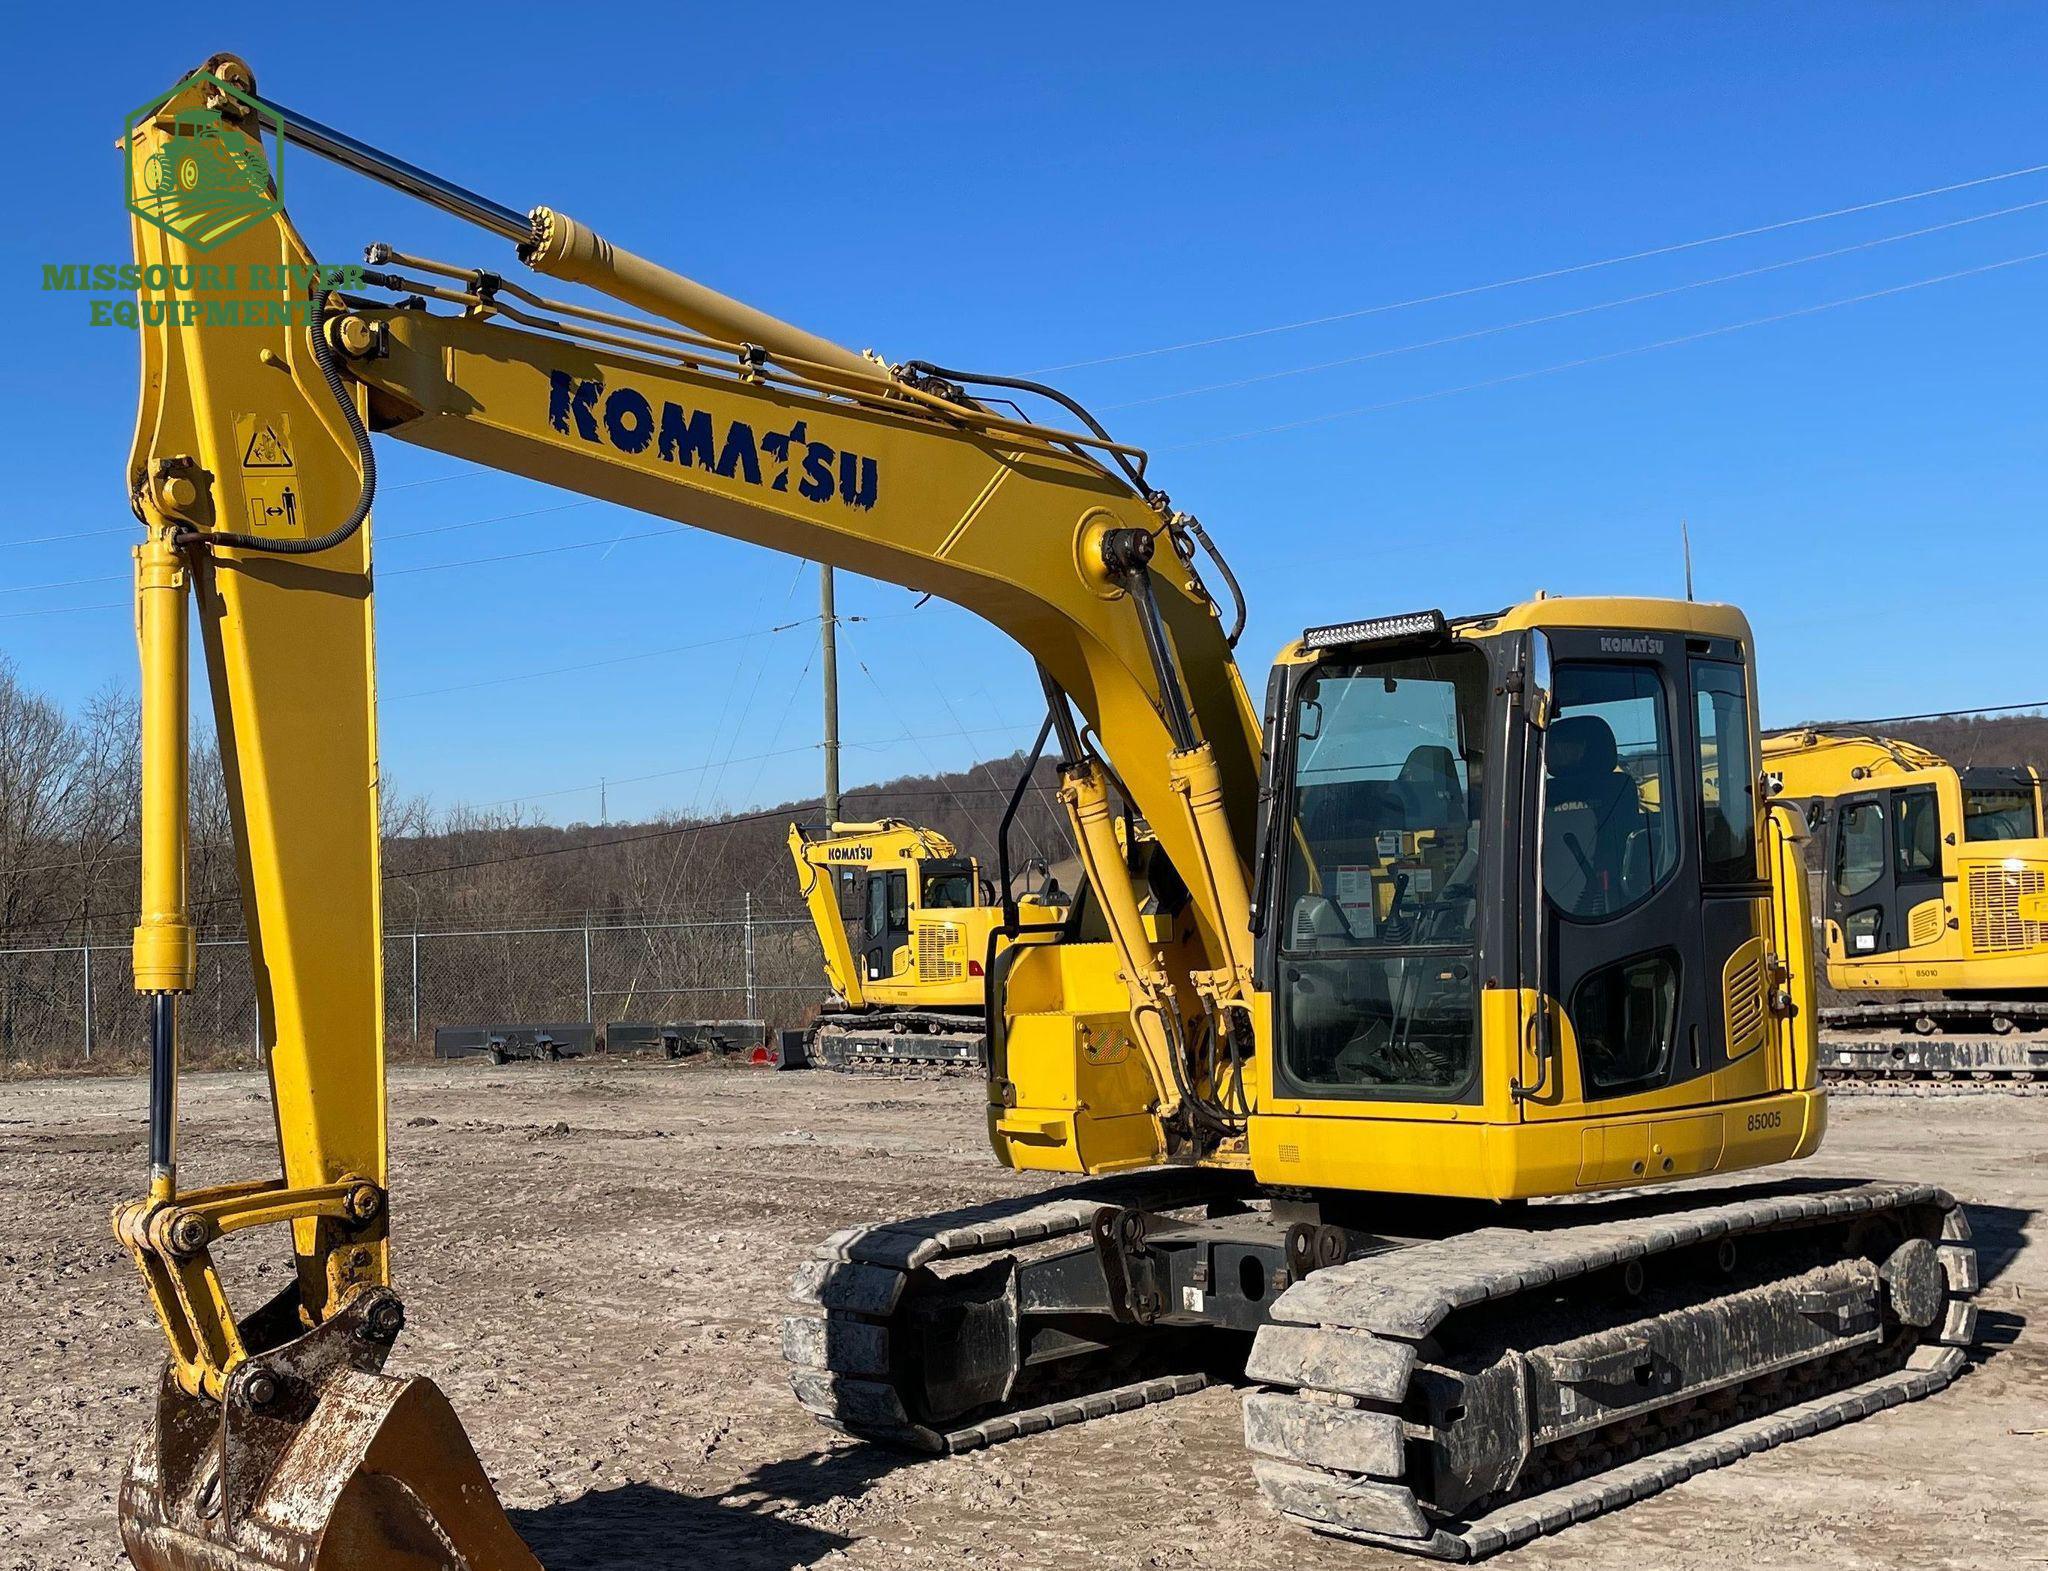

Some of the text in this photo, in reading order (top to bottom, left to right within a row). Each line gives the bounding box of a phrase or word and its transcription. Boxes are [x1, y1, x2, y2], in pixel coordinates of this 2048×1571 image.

[549, 369, 877, 512] KOMATSU
[1600, 635, 1664, 655] KOMATSU
[828, 843, 873, 860] KOMATSU
[1747, 1111, 1782, 1132] 85005
